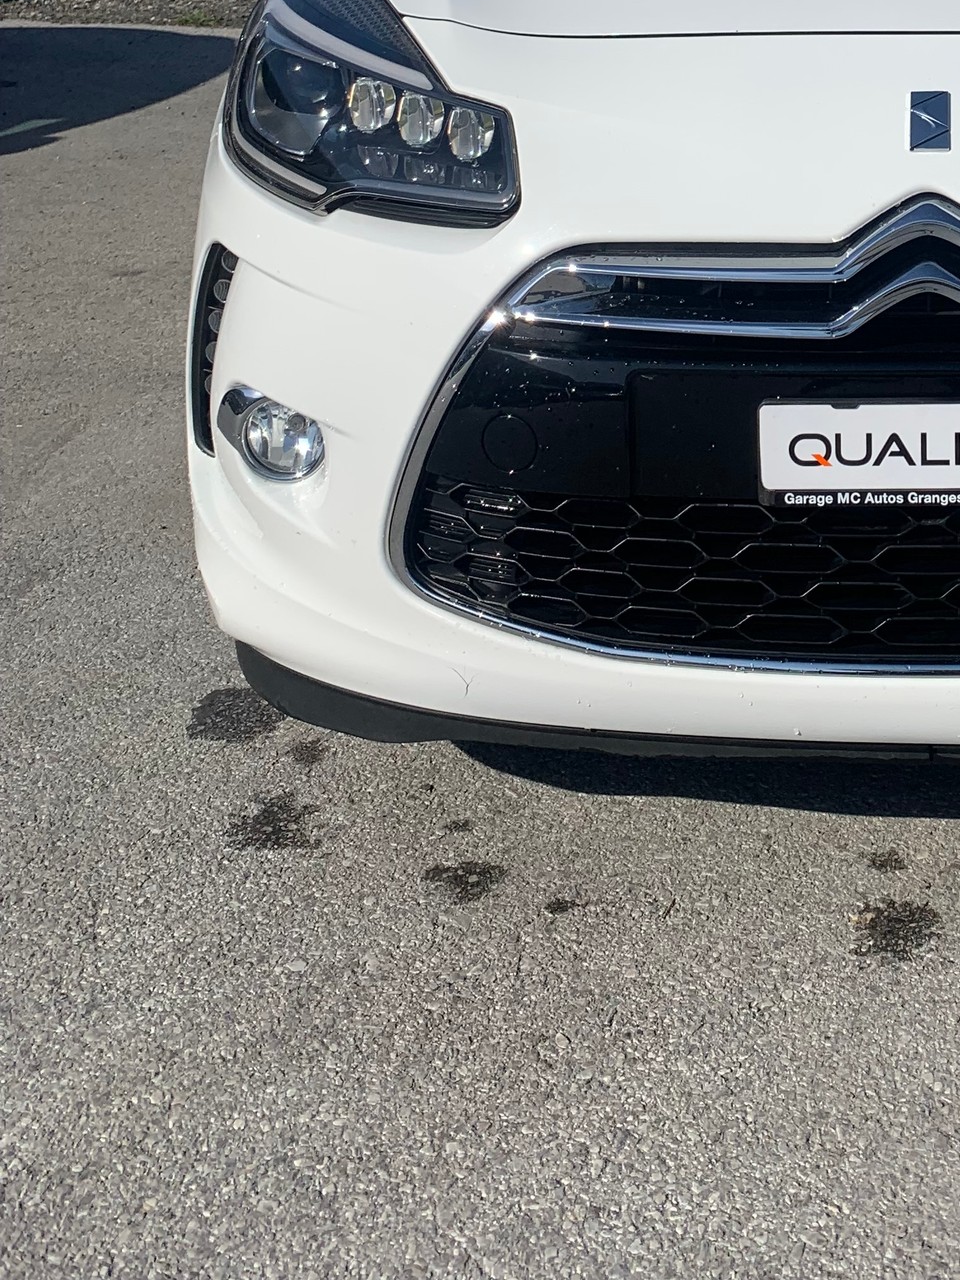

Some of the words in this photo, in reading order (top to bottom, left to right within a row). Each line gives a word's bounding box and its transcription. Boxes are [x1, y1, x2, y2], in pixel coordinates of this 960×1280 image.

[784, 492, 834, 506] Garage
[837, 492, 861, 504] MC
[864, 492, 904, 504] Autos
